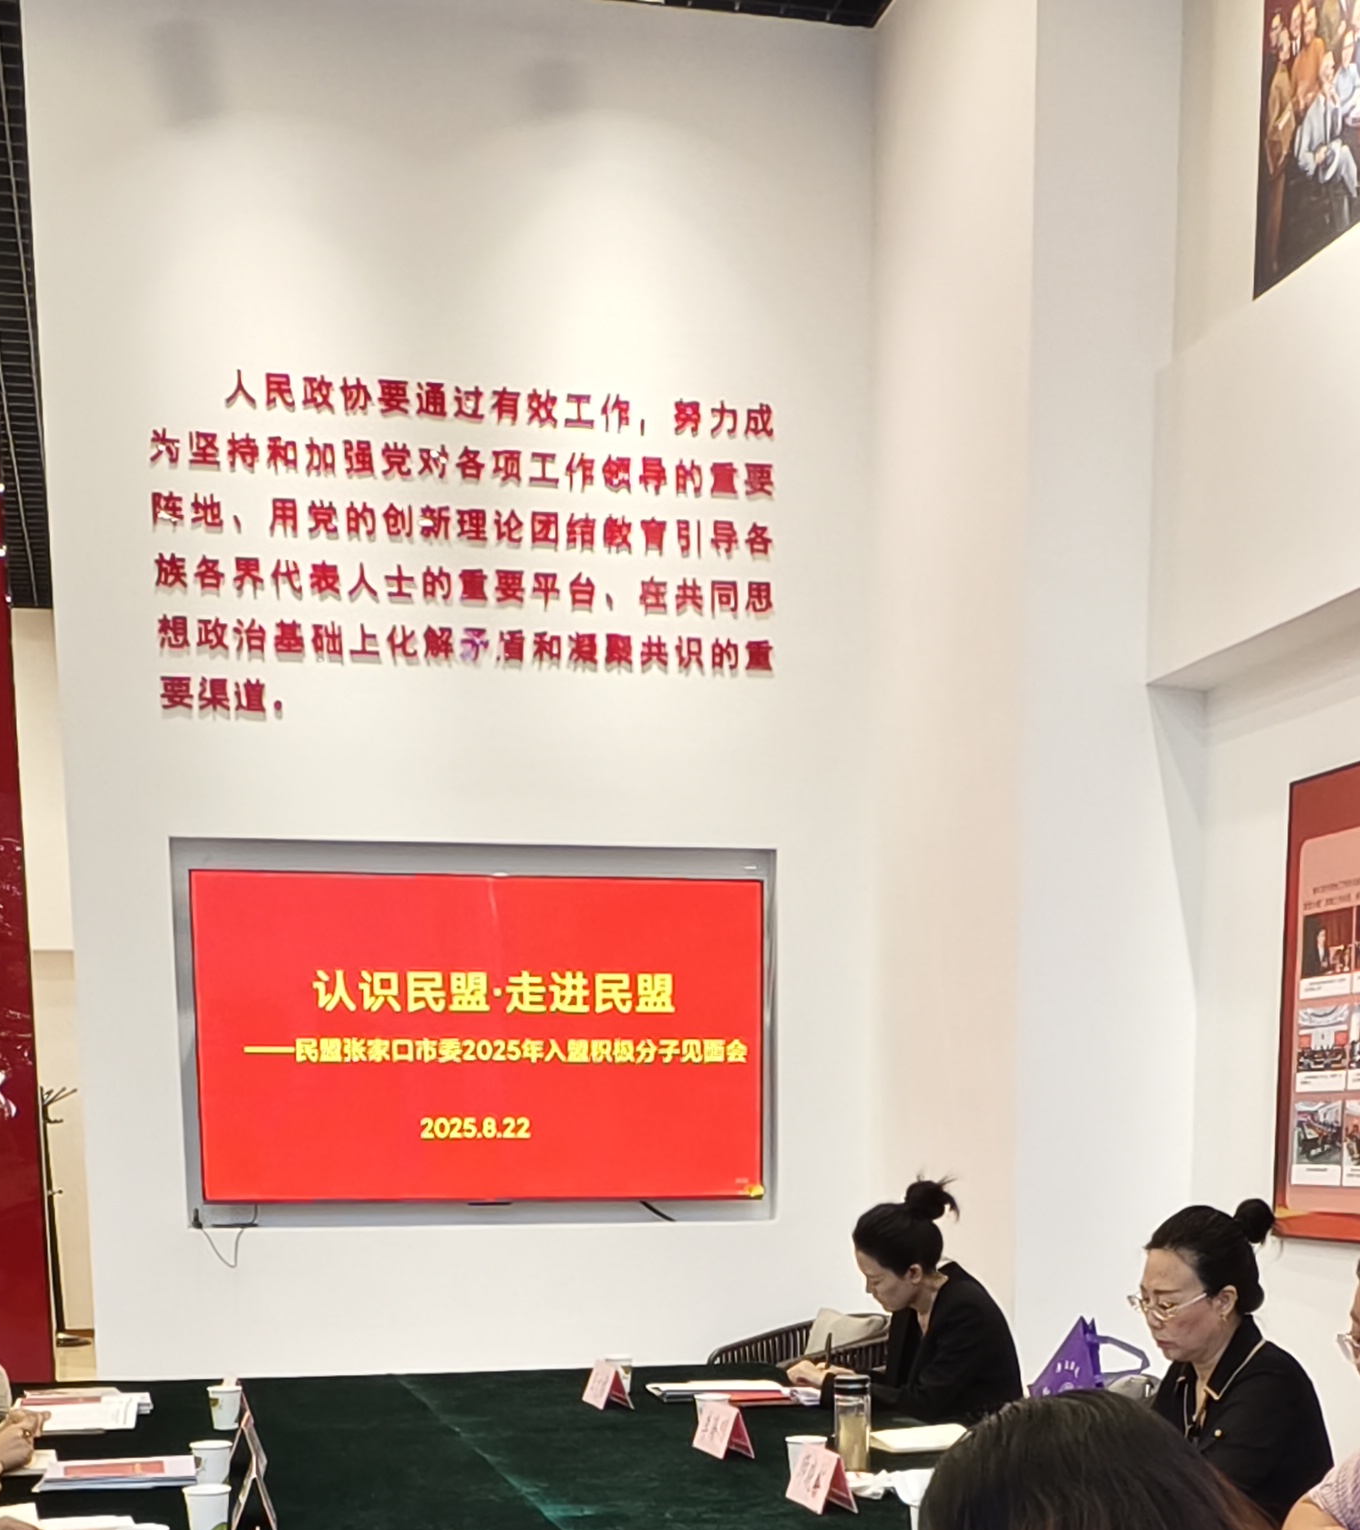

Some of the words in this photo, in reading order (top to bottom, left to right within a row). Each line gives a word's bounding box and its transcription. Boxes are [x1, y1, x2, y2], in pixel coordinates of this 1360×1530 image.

[225, 370, 774, 439] 人民政协要通过有效工作，努力成
[150, 428, 774, 497] 为坚持和加强党对各项工作领导的重要
[150, 492, 774, 557] 阵地、用党的创新理论团结教育引导各
[158, 614, 774, 673] 想政治基础上化解矛盾和凝聚共识的重
[160, 674, 284, 717] 要渠道。
[312, 969, 675, 1014] 认识民盟·走进民盟
[420, 1117, 531, 1140] 2025.8.22
